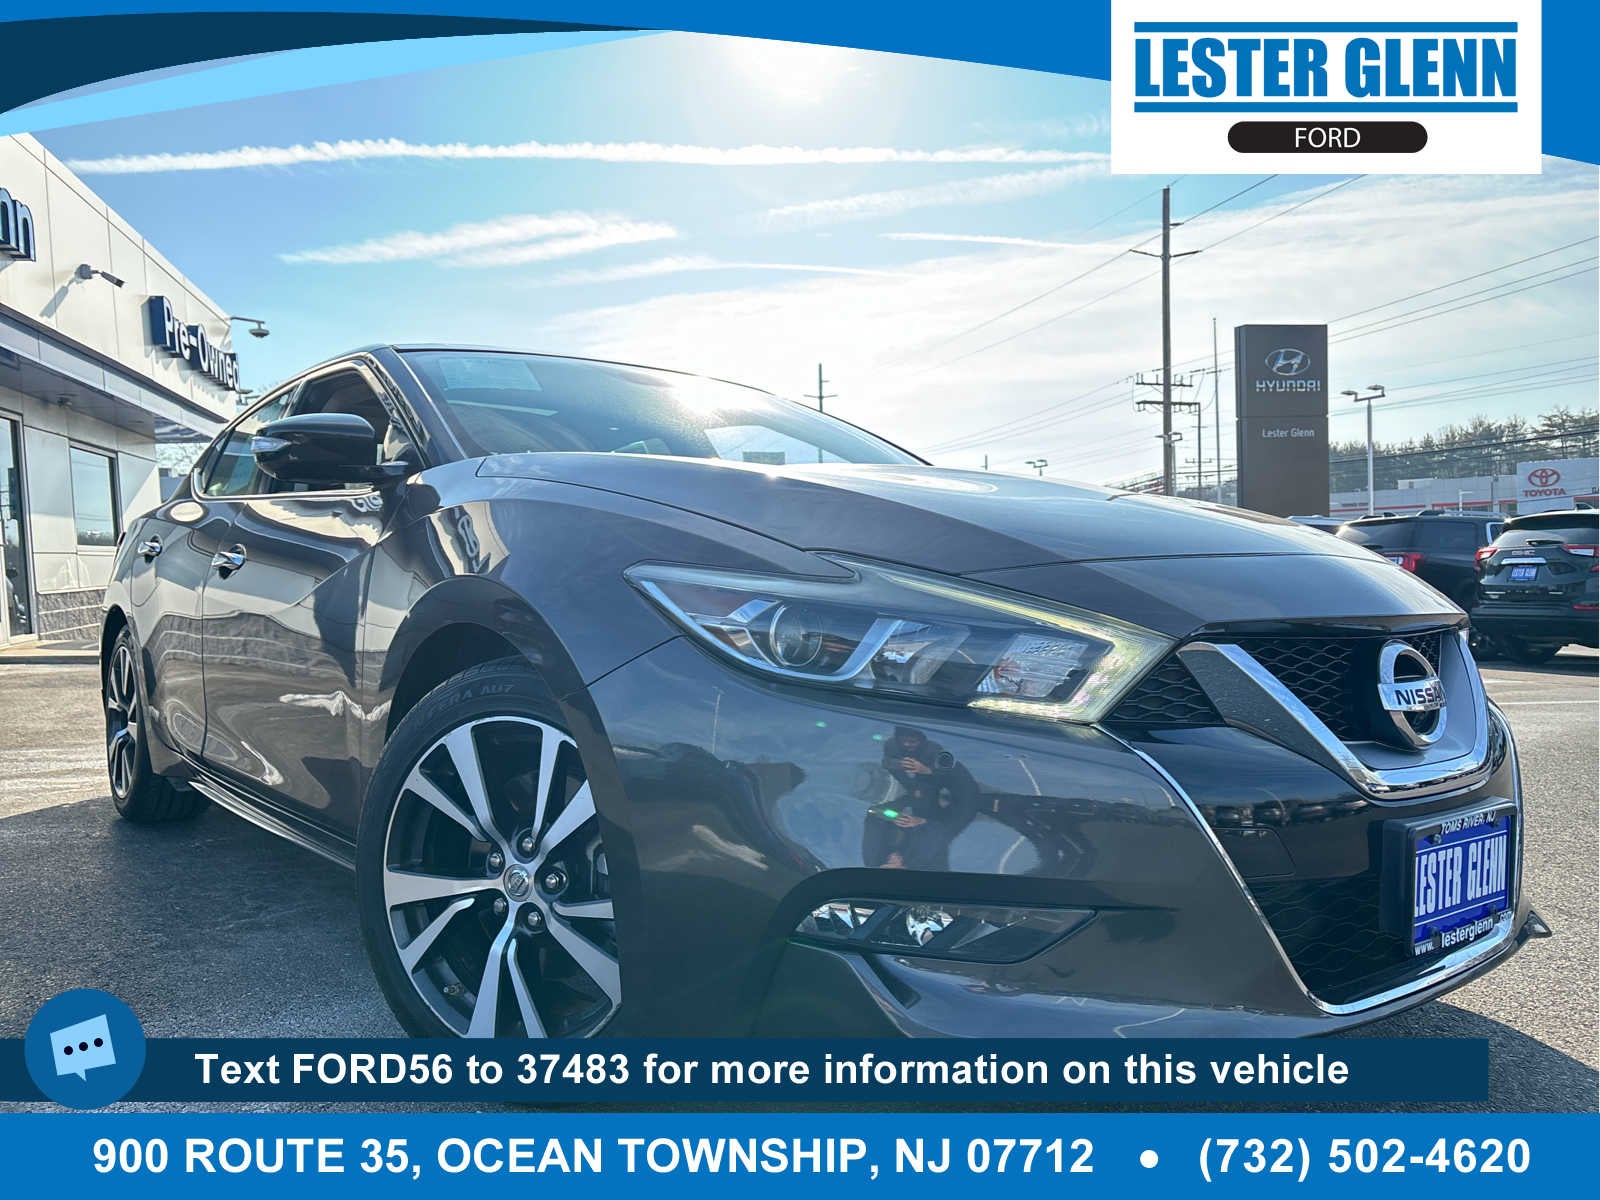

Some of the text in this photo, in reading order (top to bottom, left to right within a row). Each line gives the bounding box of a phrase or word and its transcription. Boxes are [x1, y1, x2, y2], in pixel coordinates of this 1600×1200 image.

[162, 296, 240, 392] Pre-Owned
[1256, 379, 1321, 392] HYUNDAI
[1262, 427, 1315, 438] Lester Glenn
[1523, 487, 1567, 497] TOYOTA
[1441, 818, 1462, 836] TOMS
[1486, 810, 1497, 823] NJ
[1414, 834, 1507, 918] LESTER GLENN
[1441, 918, 1494, 949] lesterglenn
